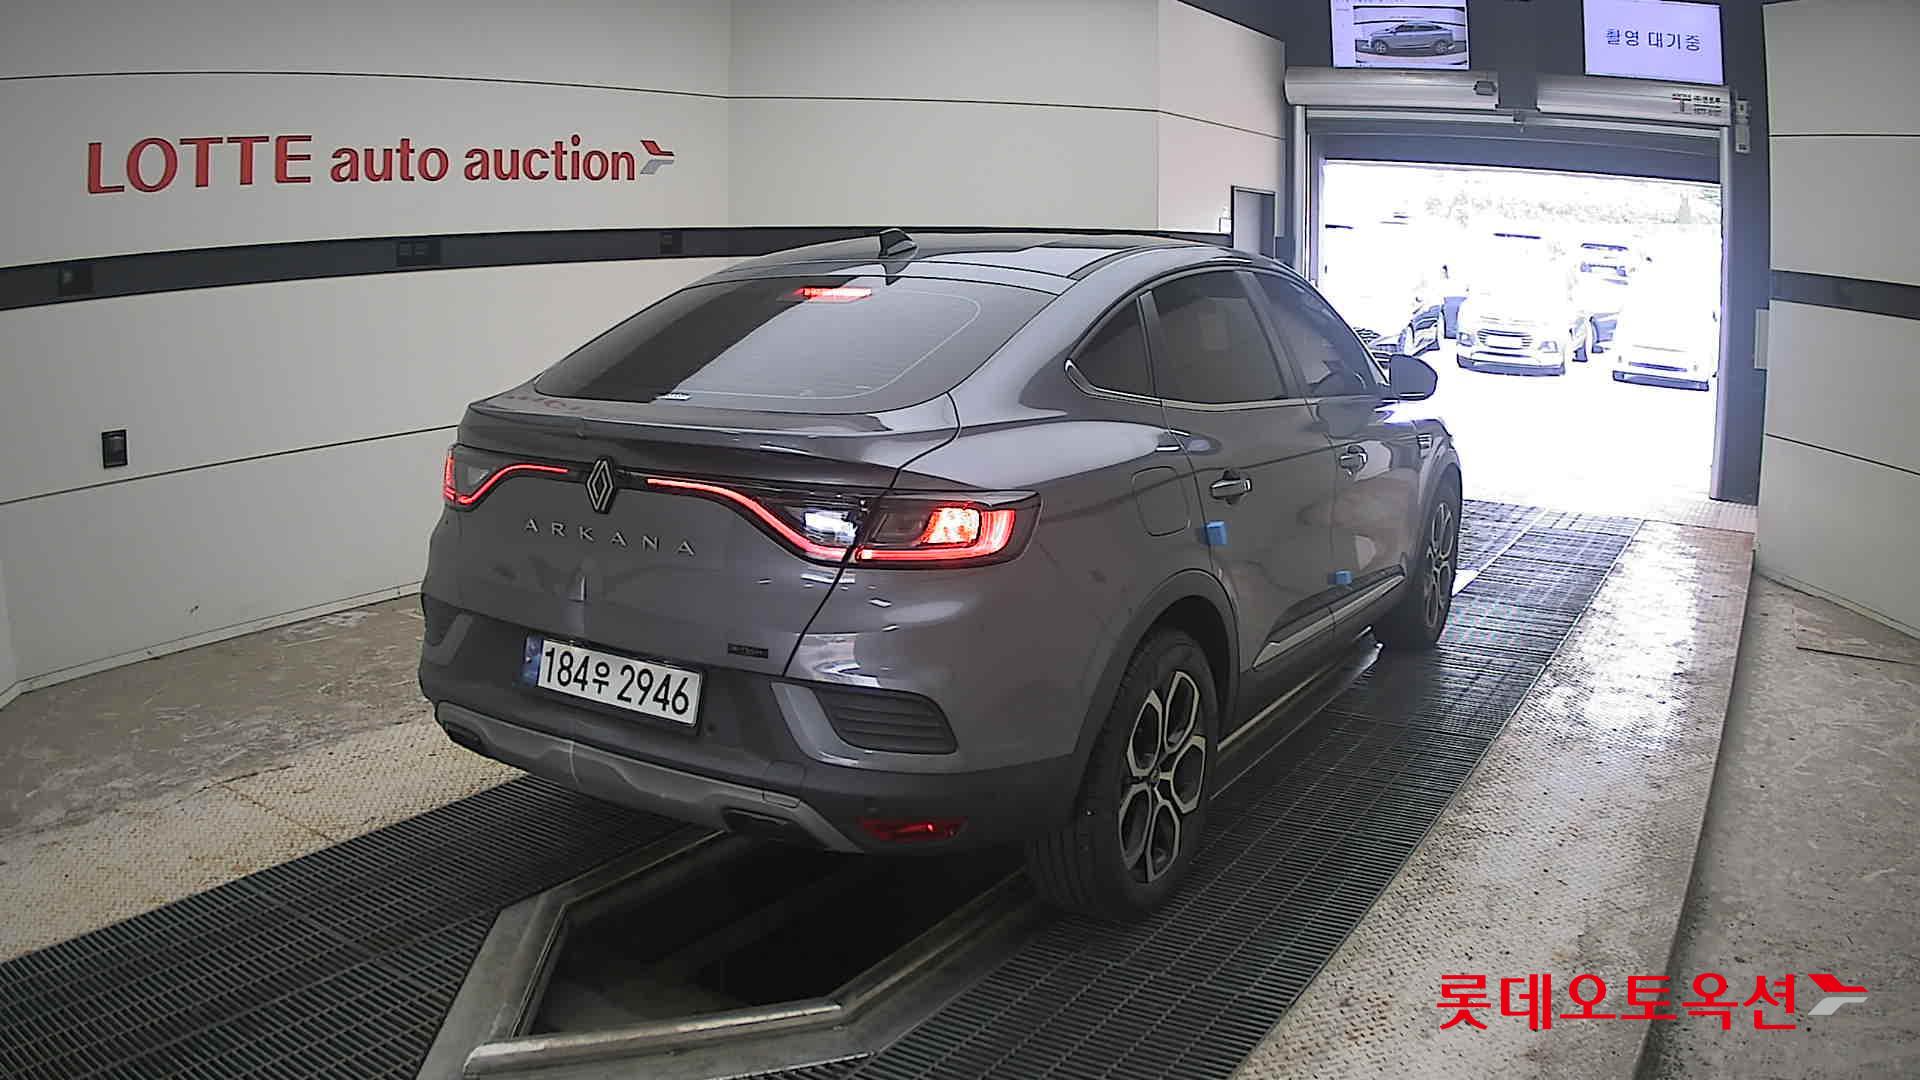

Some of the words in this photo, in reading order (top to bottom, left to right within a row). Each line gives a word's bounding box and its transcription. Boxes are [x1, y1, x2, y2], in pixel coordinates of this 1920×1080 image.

[1647, 31, 1701, 52] 대기중
[87, 135, 312, 194] LOTTE
[330, 138, 449, 183] auto
[463, 134, 636, 182] auction
[524, 518, 696, 556] ARKANA
[544, 647, 610, 694] 184우
[616, 664, 690, 715] 2946
